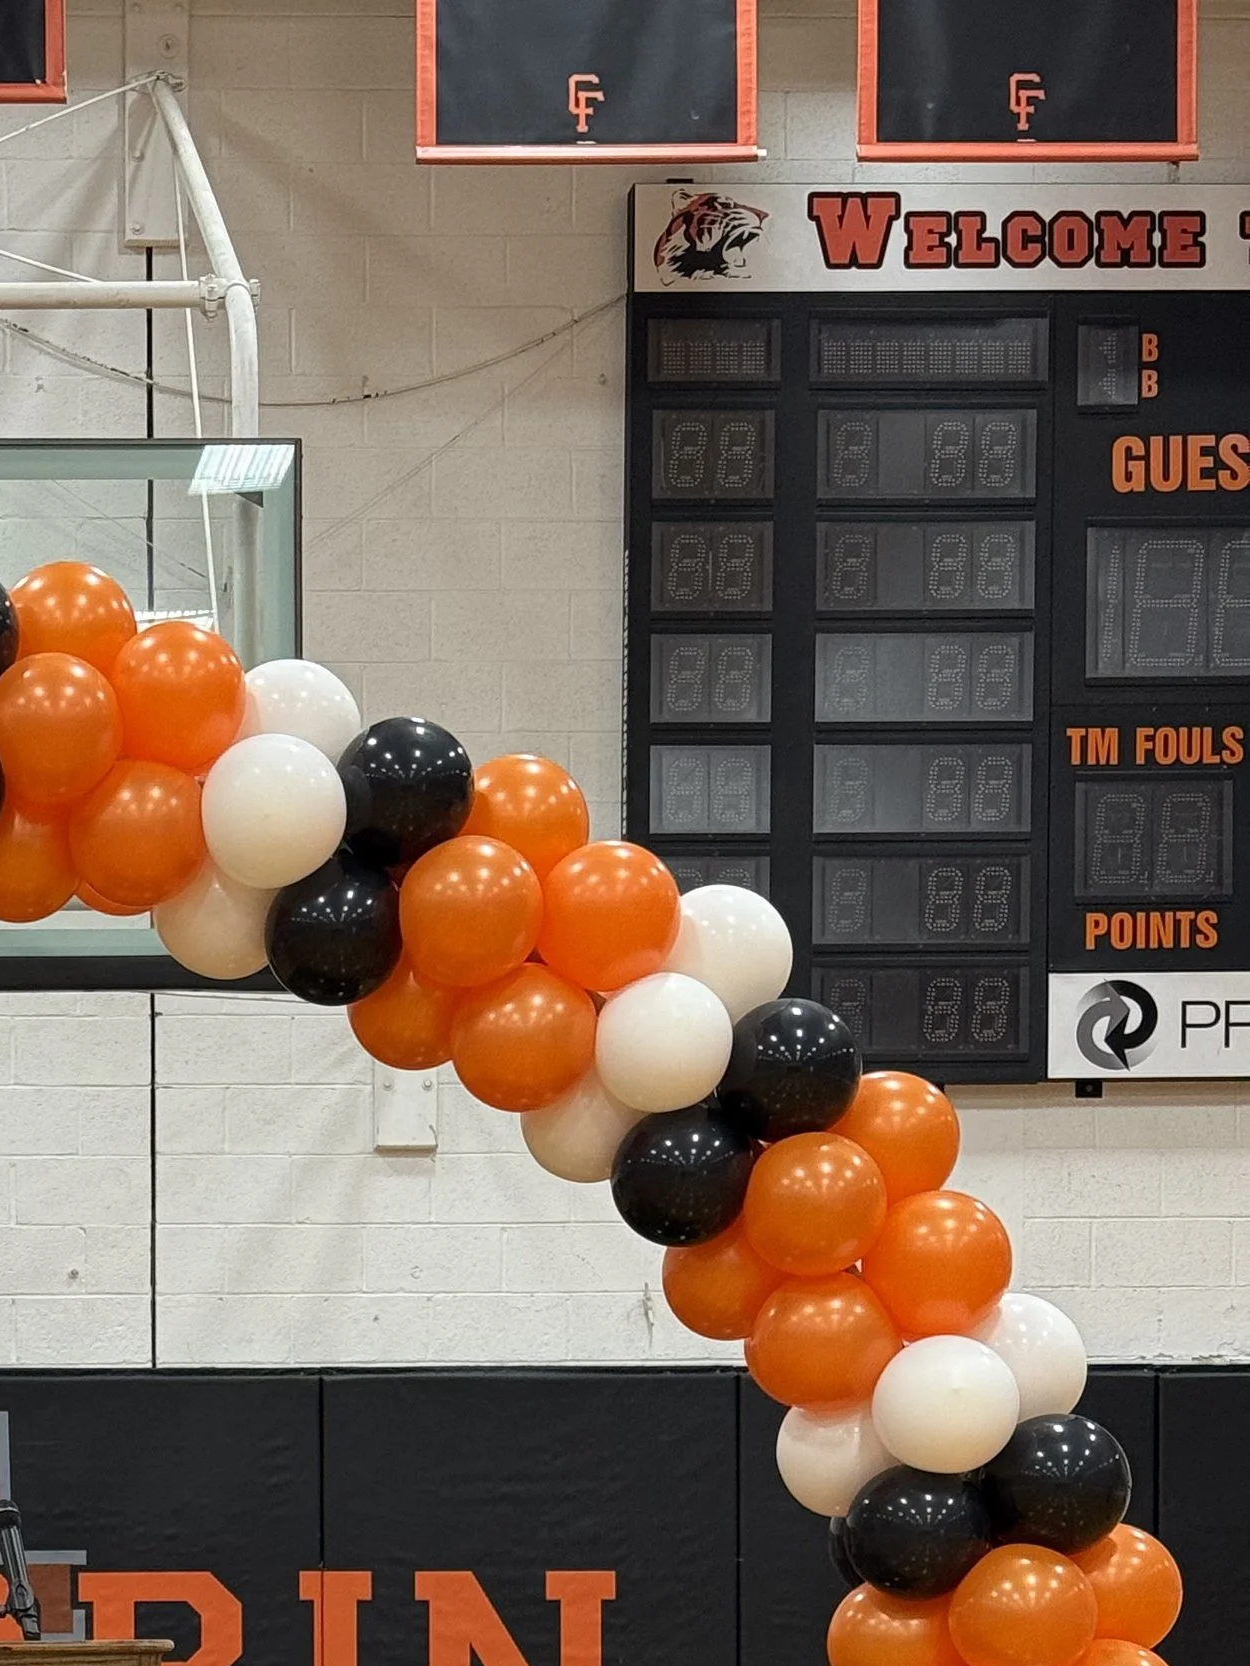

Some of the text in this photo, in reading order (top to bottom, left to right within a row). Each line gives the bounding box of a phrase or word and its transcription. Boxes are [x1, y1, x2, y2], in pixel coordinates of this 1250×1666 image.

[1141, 332, 1160, 362] B
[1141, 369, 1160, 398] B
[1066, 726, 1245, 766] TM FOULS
[1084, 910, 1219, 951] POINTS
